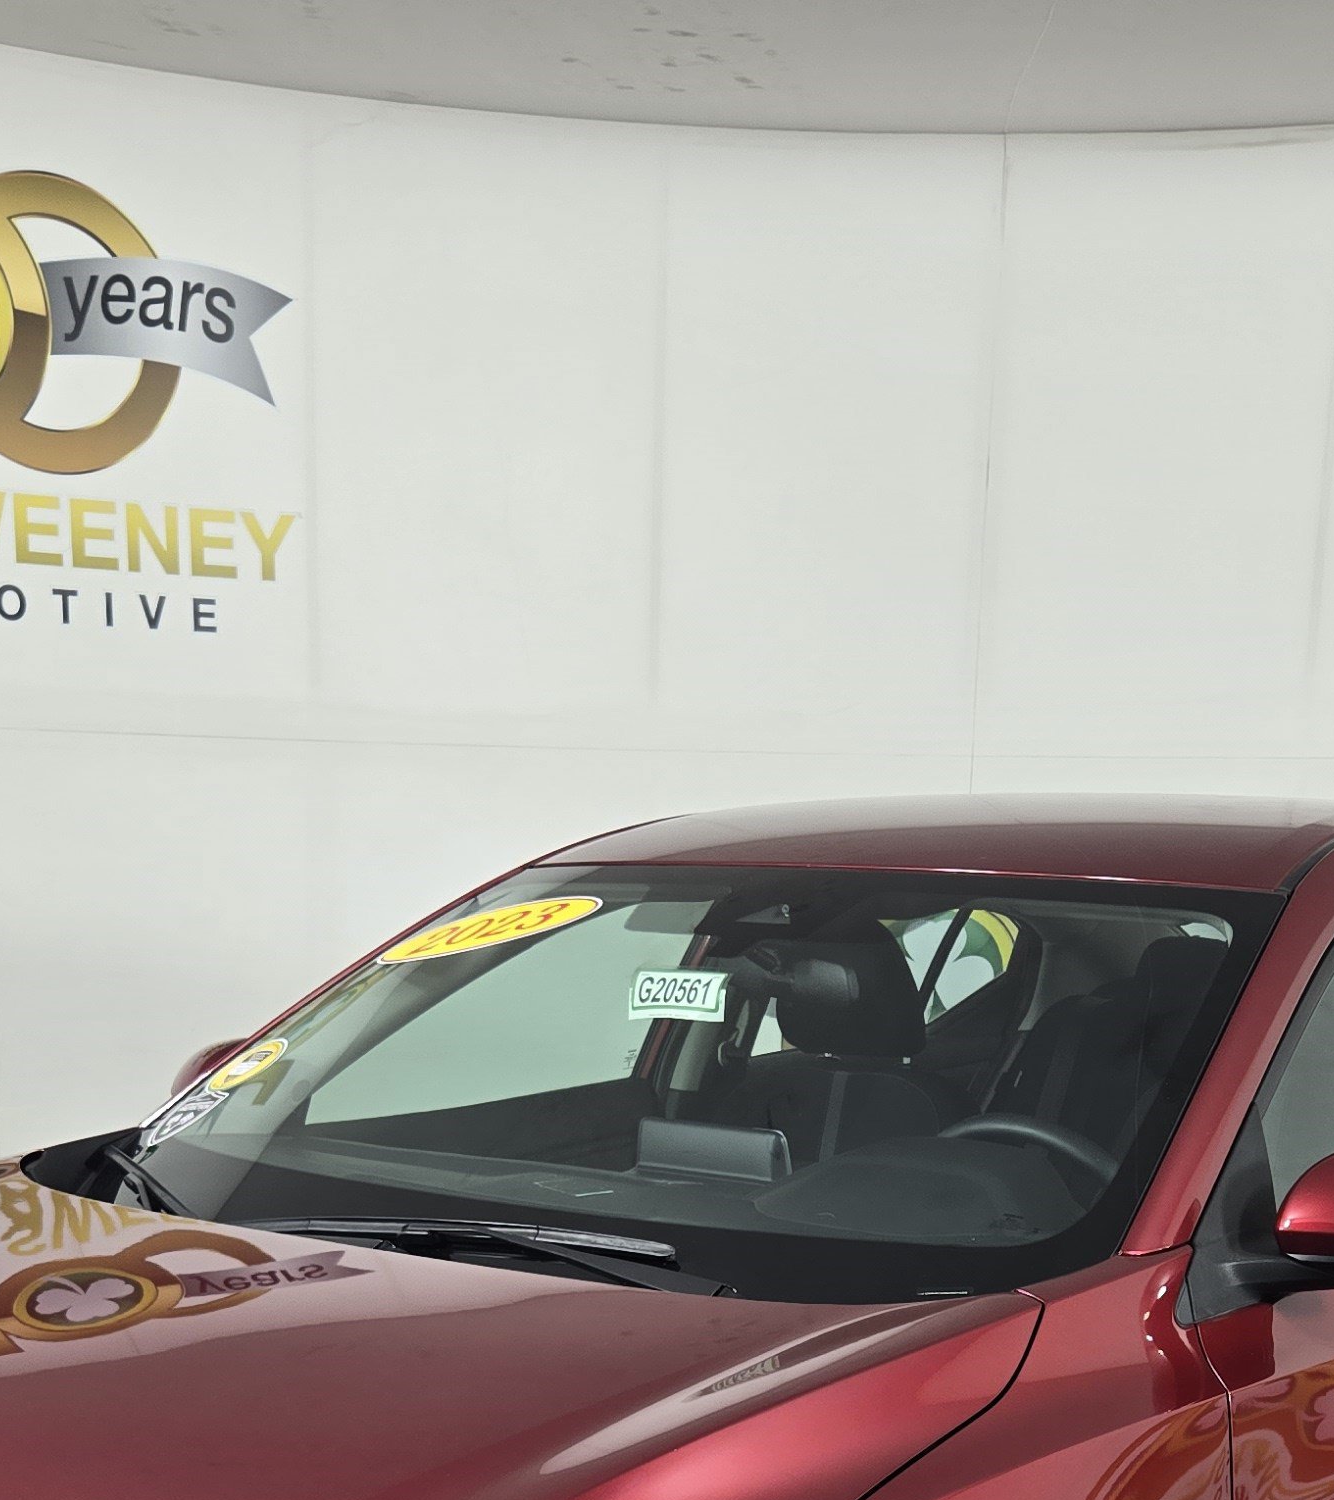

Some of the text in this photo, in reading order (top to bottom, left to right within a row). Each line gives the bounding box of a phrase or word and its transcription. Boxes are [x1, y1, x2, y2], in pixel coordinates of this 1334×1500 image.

[62, 270, 236, 343] years
[405, 902, 571, 957] 2023
[638, 976, 714, 1006] G20561
